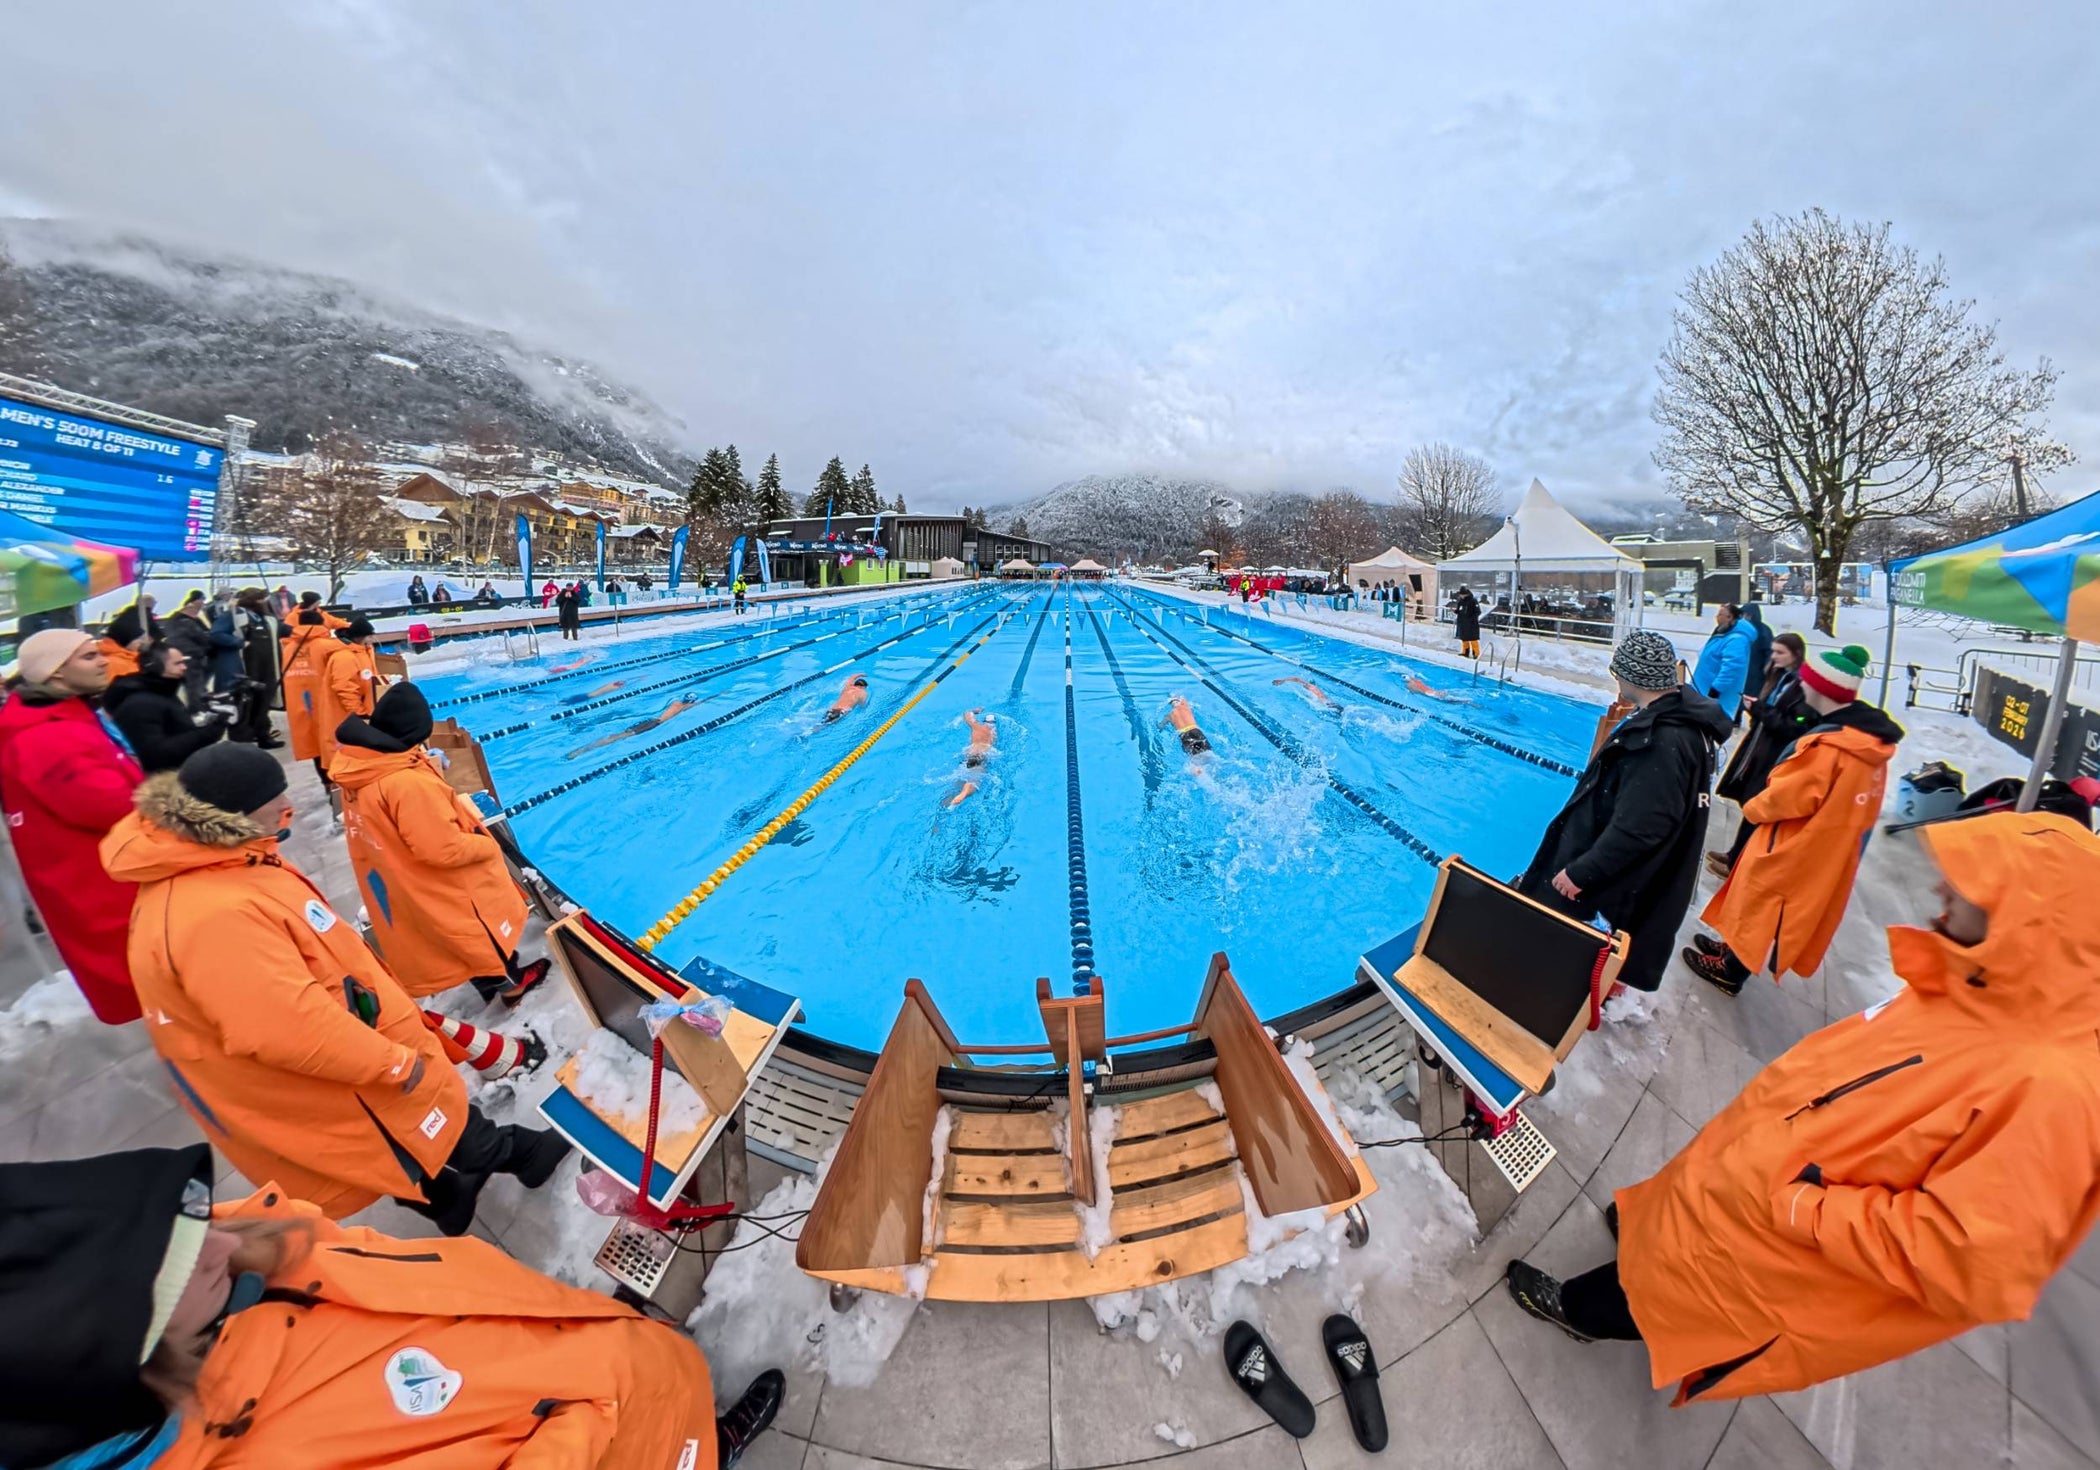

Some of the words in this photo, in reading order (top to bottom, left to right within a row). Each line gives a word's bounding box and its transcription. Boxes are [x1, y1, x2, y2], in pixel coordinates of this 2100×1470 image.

[0, 407, 55, 429] MEN'S
[57, 420, 104, 440] 500M
[106, 431, 181, 456] FREESTYLE
[55, 433, 91, 448] HEAT
[103, 443, 121, 453] OF
[2000, 717, 2025, 740] 2026
[426, 1109, 442, 1133] red
[1337, 1341, 1367, 1357] adidas
[1238, 1345, 1263, 1377] adidas
